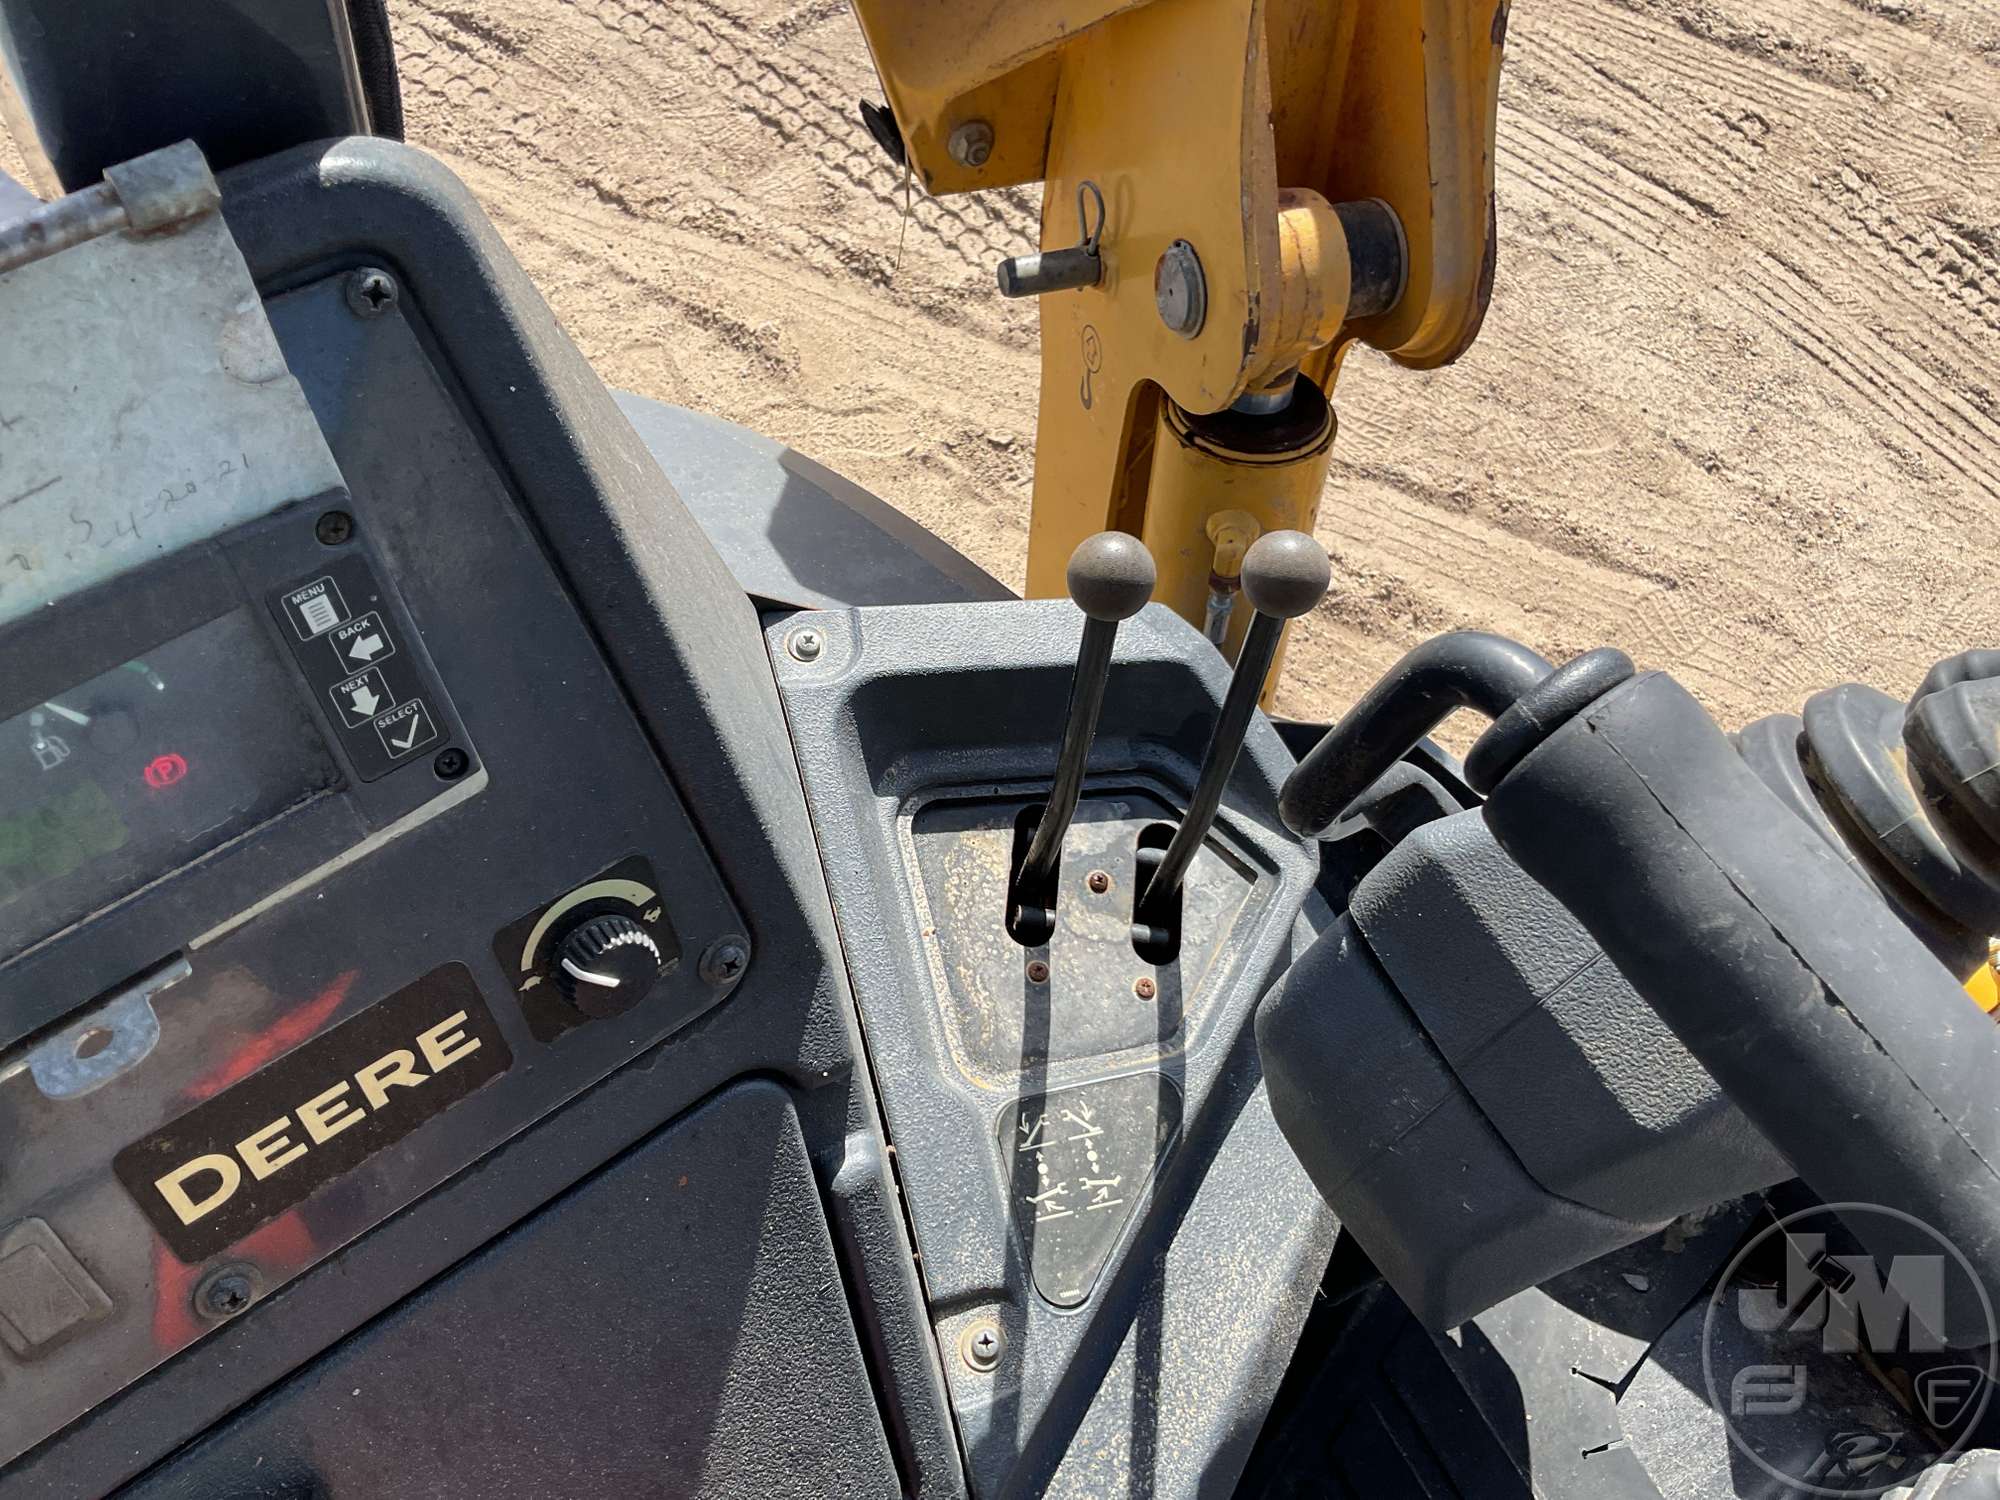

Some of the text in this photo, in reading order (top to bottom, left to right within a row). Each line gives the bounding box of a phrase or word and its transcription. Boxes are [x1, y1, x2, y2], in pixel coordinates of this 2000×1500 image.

[291, 583, 326, 605] MENU
[337, 618, 371, 640] BACK
[340, 674, 370, 694] NEXT
[377, 702, 419, 729] SELECT
[154, 1010, 481, 1226] DEERE
